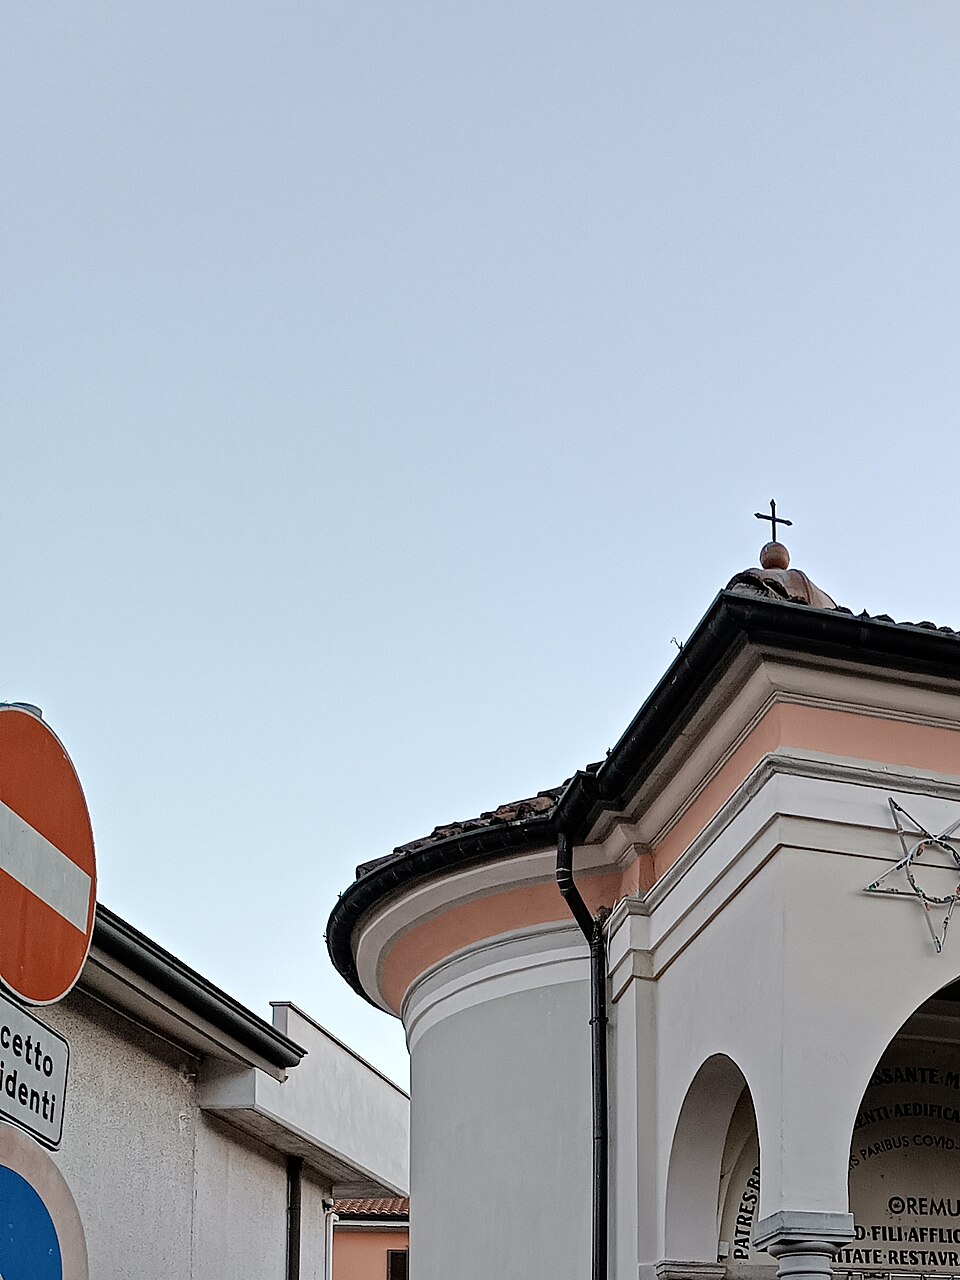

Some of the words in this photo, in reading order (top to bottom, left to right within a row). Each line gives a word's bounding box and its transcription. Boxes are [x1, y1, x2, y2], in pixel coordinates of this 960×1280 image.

[0, 1025, 54, 1078] cetto
[0, 1060, 56, 1124] identi
[733, 1191, 758, 1260] PATRES
[868, 1066, 940, 1088] SSANTE
[859, 1135, 910, 1161] PARIBUS
